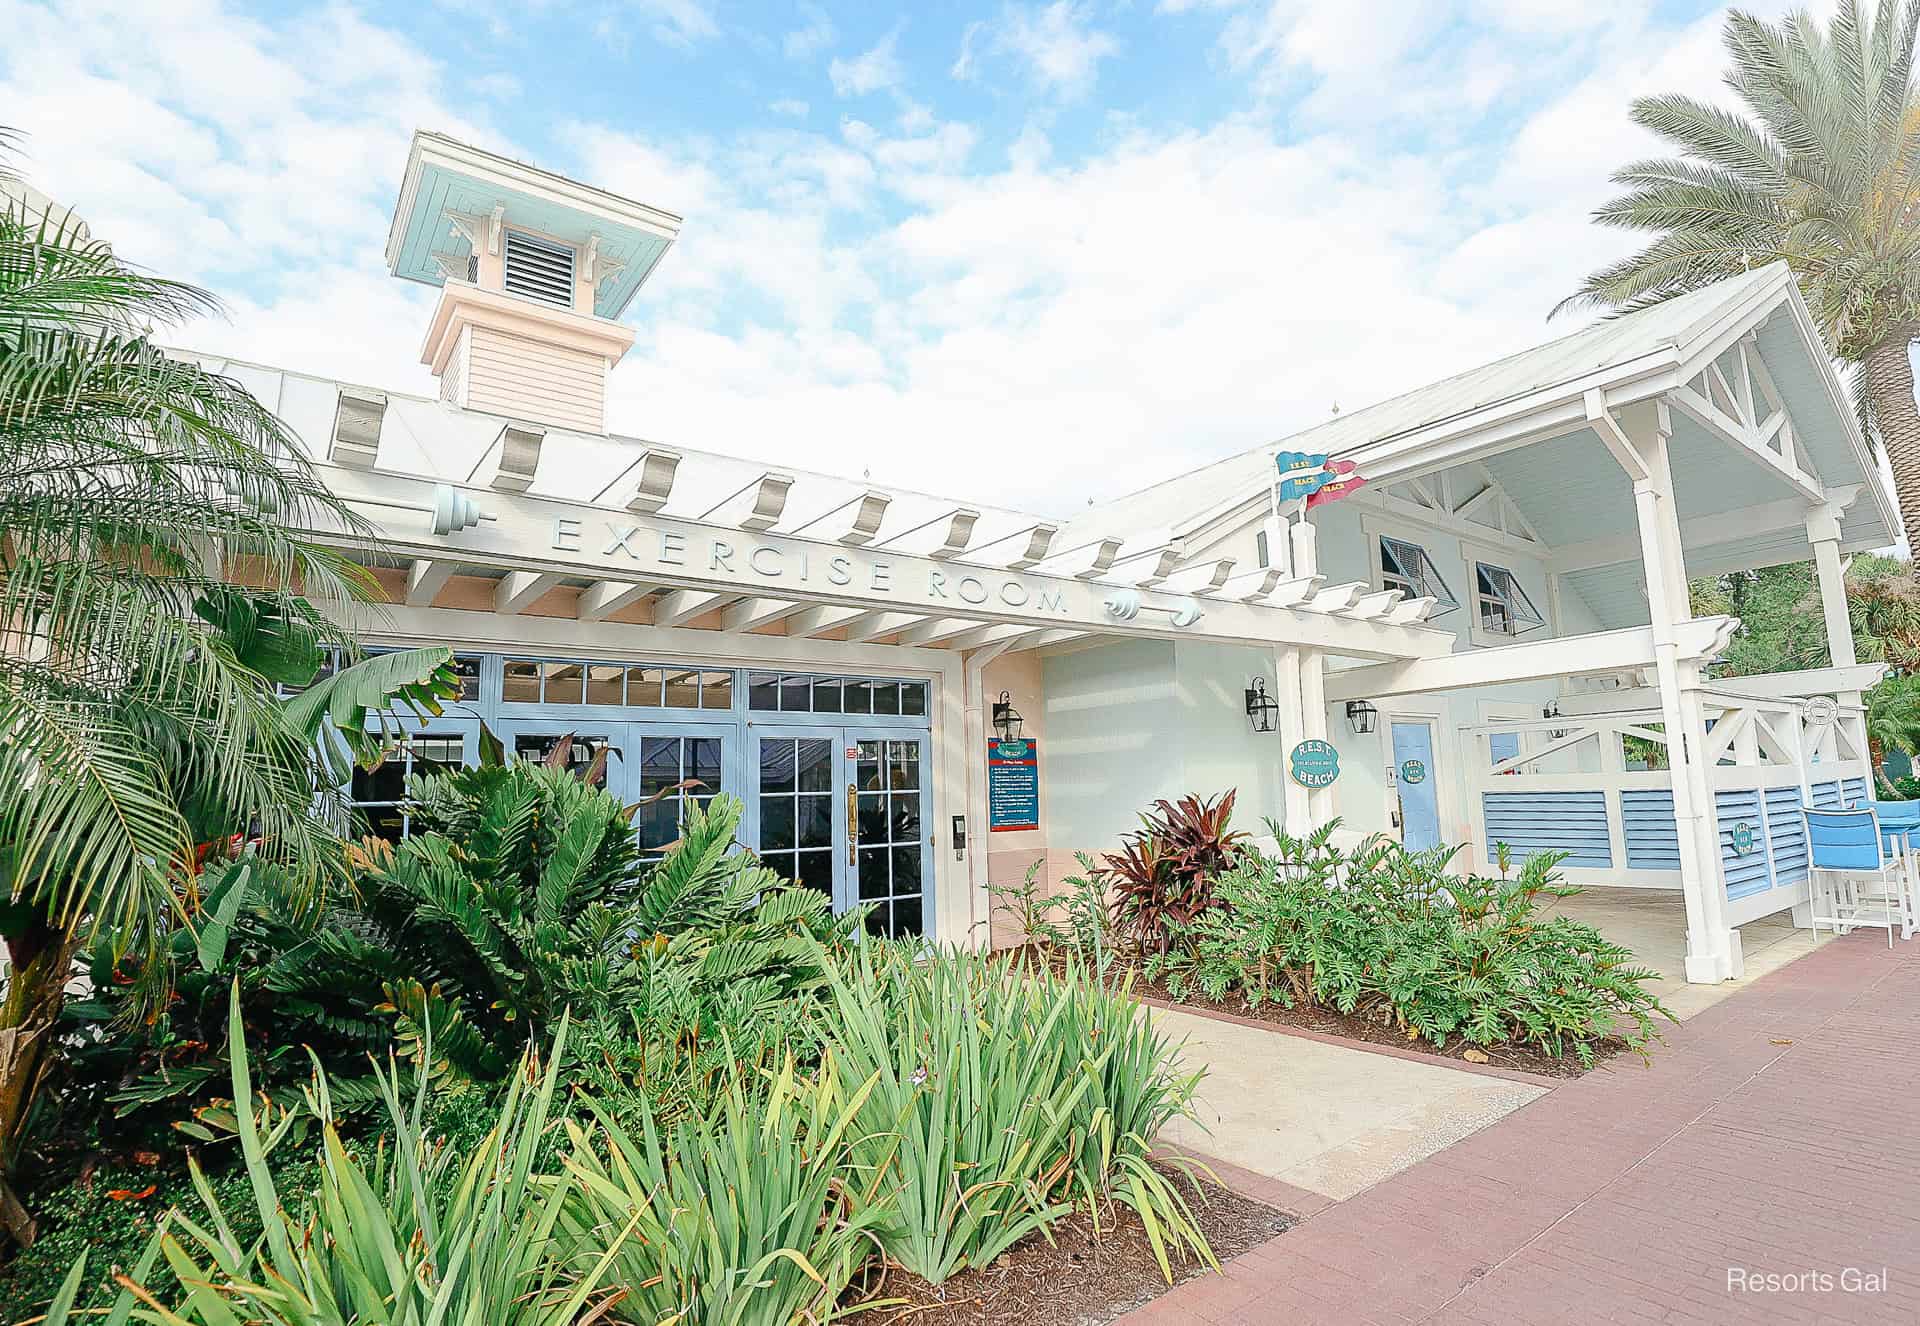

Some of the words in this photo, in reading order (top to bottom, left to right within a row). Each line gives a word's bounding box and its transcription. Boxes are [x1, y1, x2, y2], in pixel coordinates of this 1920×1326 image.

[552, 513, 891, 592] EXERCISE
[927, 570, 1068, 612] ROOM
[1300, 769, 1334, 785] BEACH
